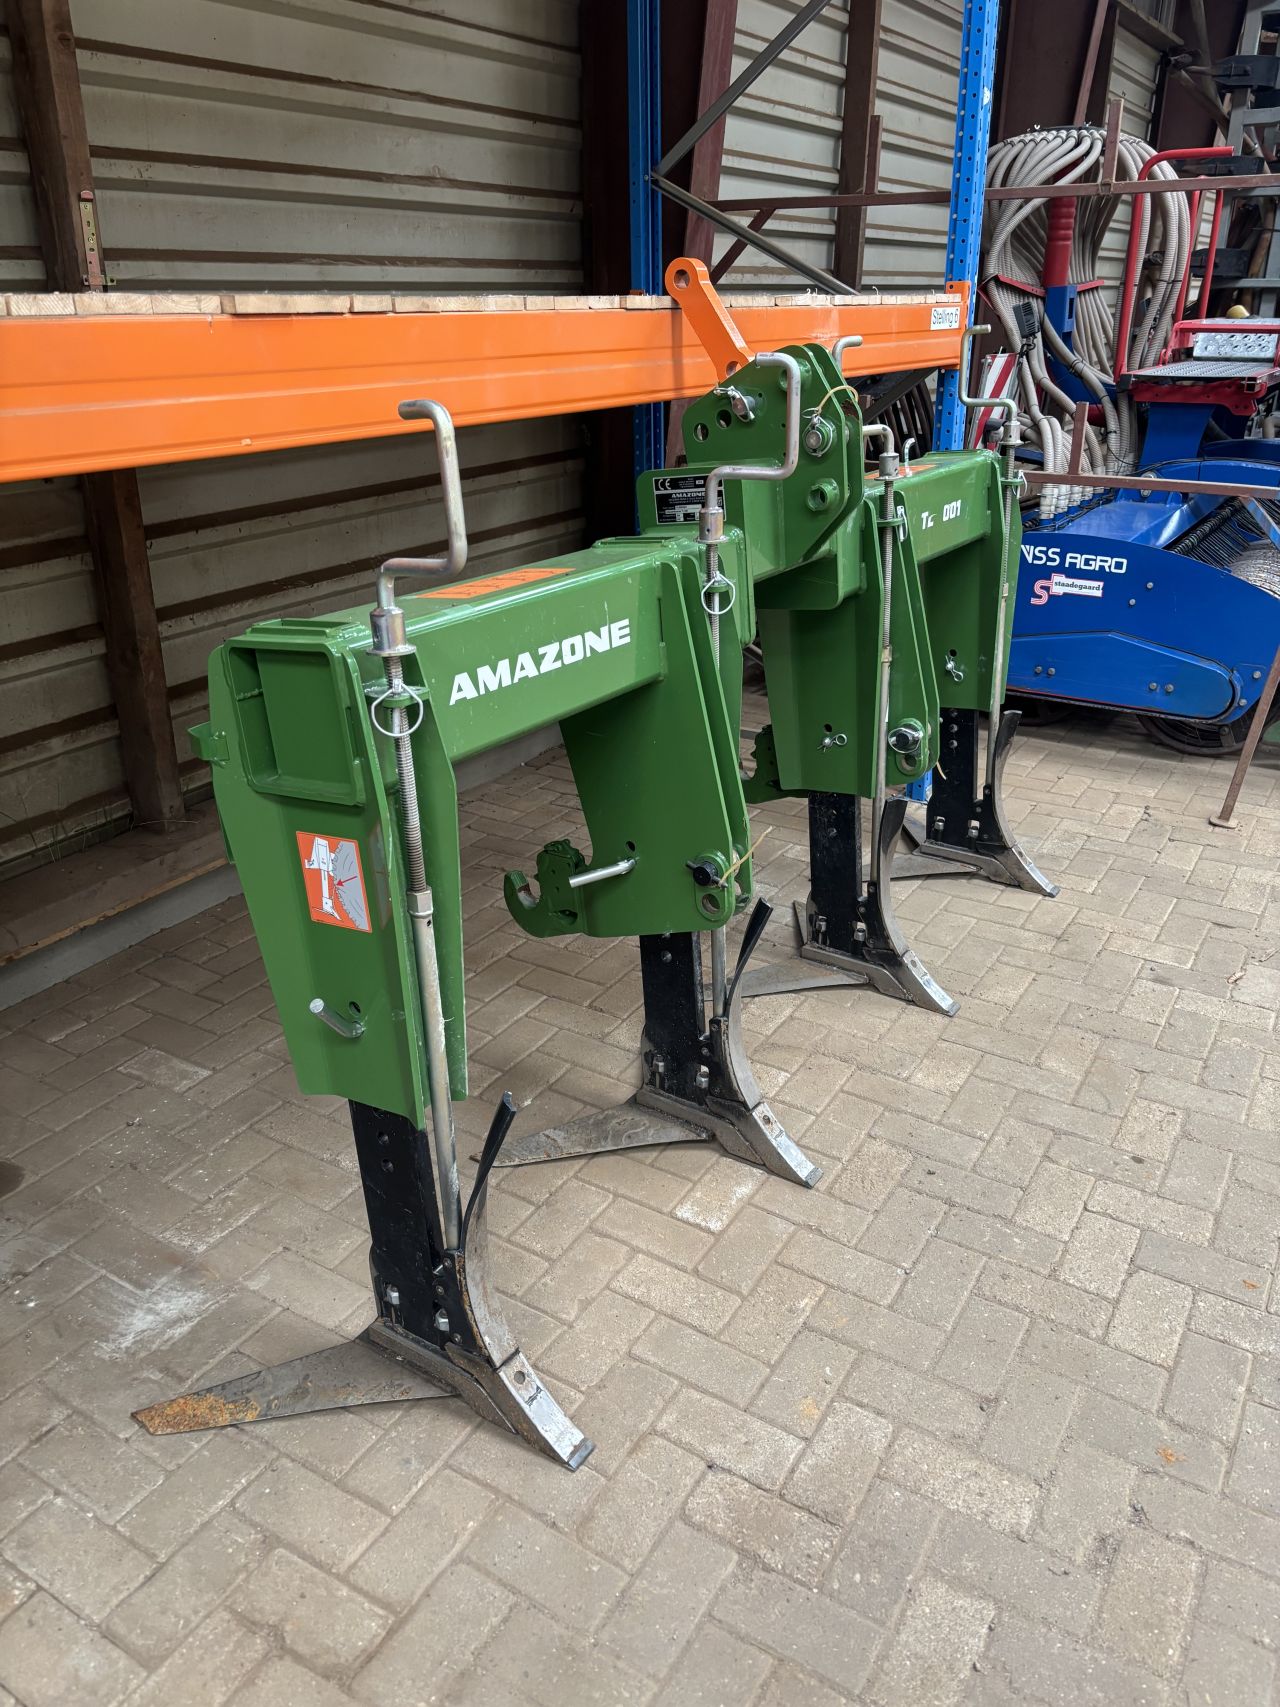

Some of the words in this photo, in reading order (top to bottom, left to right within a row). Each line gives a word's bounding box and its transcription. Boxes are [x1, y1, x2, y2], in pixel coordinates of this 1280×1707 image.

[932, 309, 954, 327] Stelling
[954, 308, 959, 323] 6
[942, 499, 962, 522] 001
[1064, 552, 1128, 574] AGRO
[449, 618, 631, 706] AMAZONE
